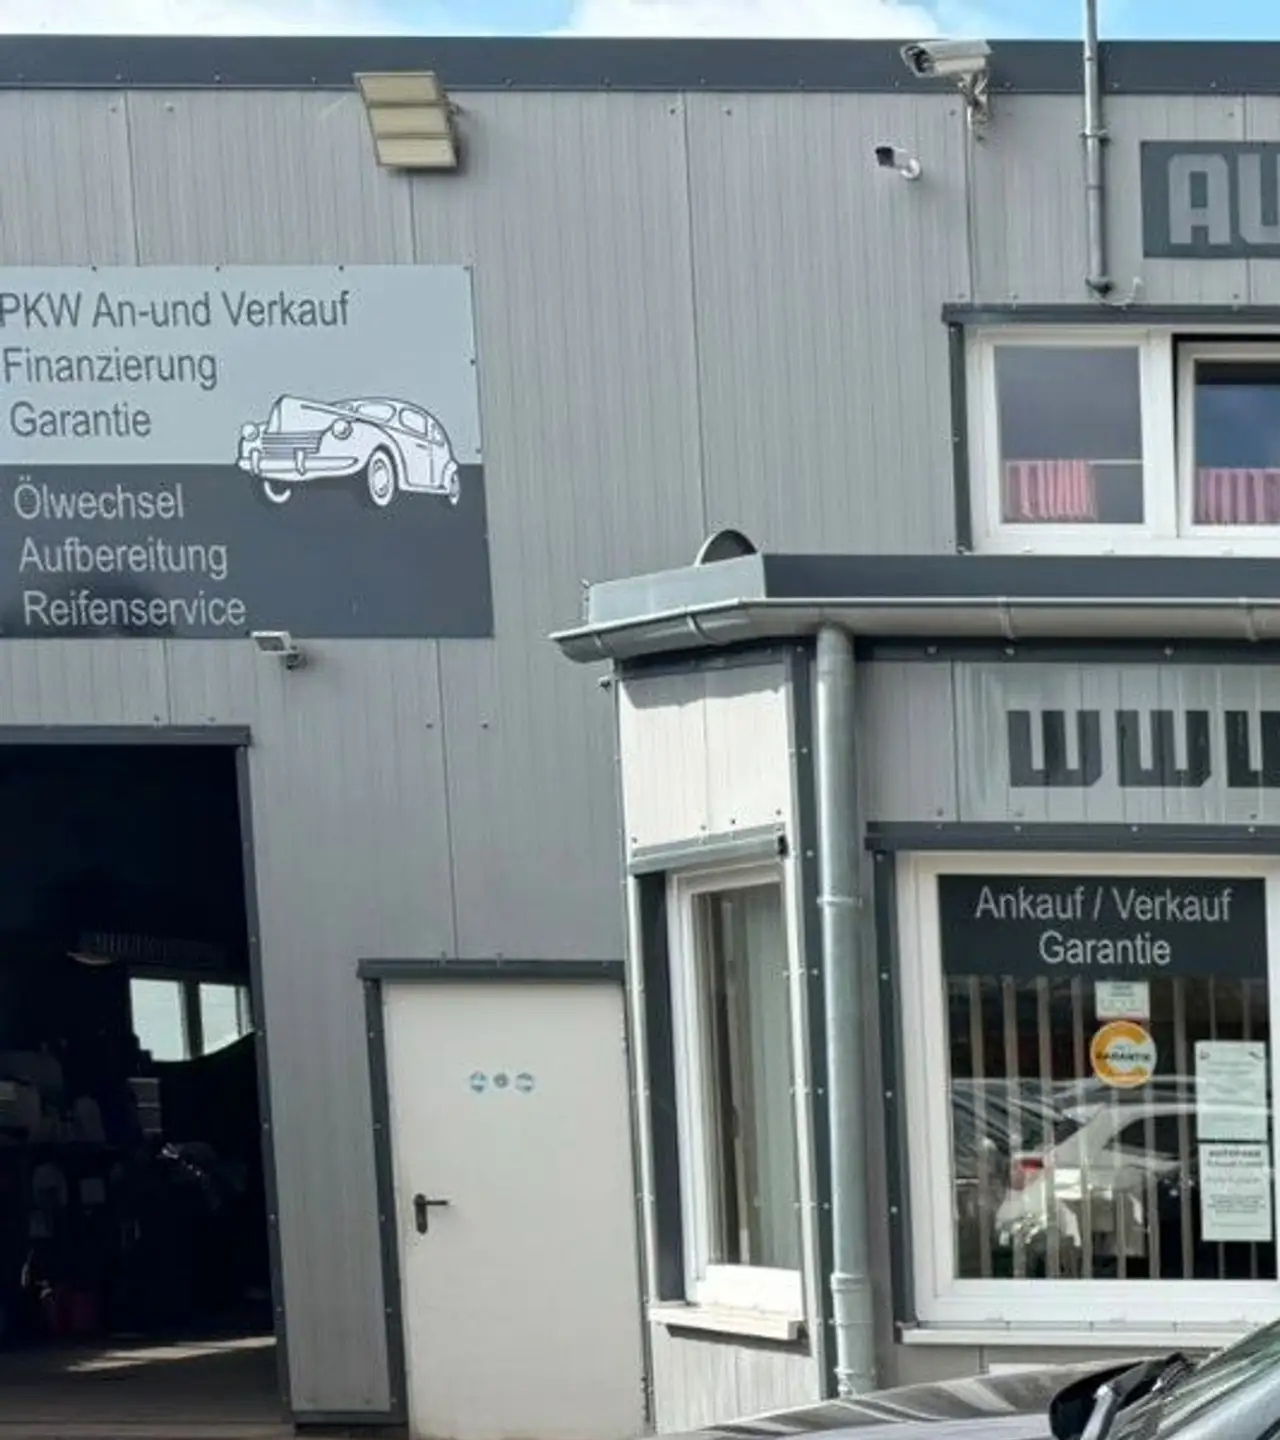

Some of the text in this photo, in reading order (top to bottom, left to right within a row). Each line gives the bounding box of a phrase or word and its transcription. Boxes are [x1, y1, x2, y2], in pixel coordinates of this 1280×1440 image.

[0, 290, 350, 329] PKW An-und Verkauf
[4, 347, 218, 391] Finanzierung
[10, 401, 152, 438] Garantie
[15, 475, 183, 521] Ölwechsel
[19, 536, 229, 583] Aufbereitung
[24, 590, 247, 628] Reifenservice
[975, 885, 1234, 921] Ankauf / Verkauf
[1039, 931, 1172, 966] Garantie
